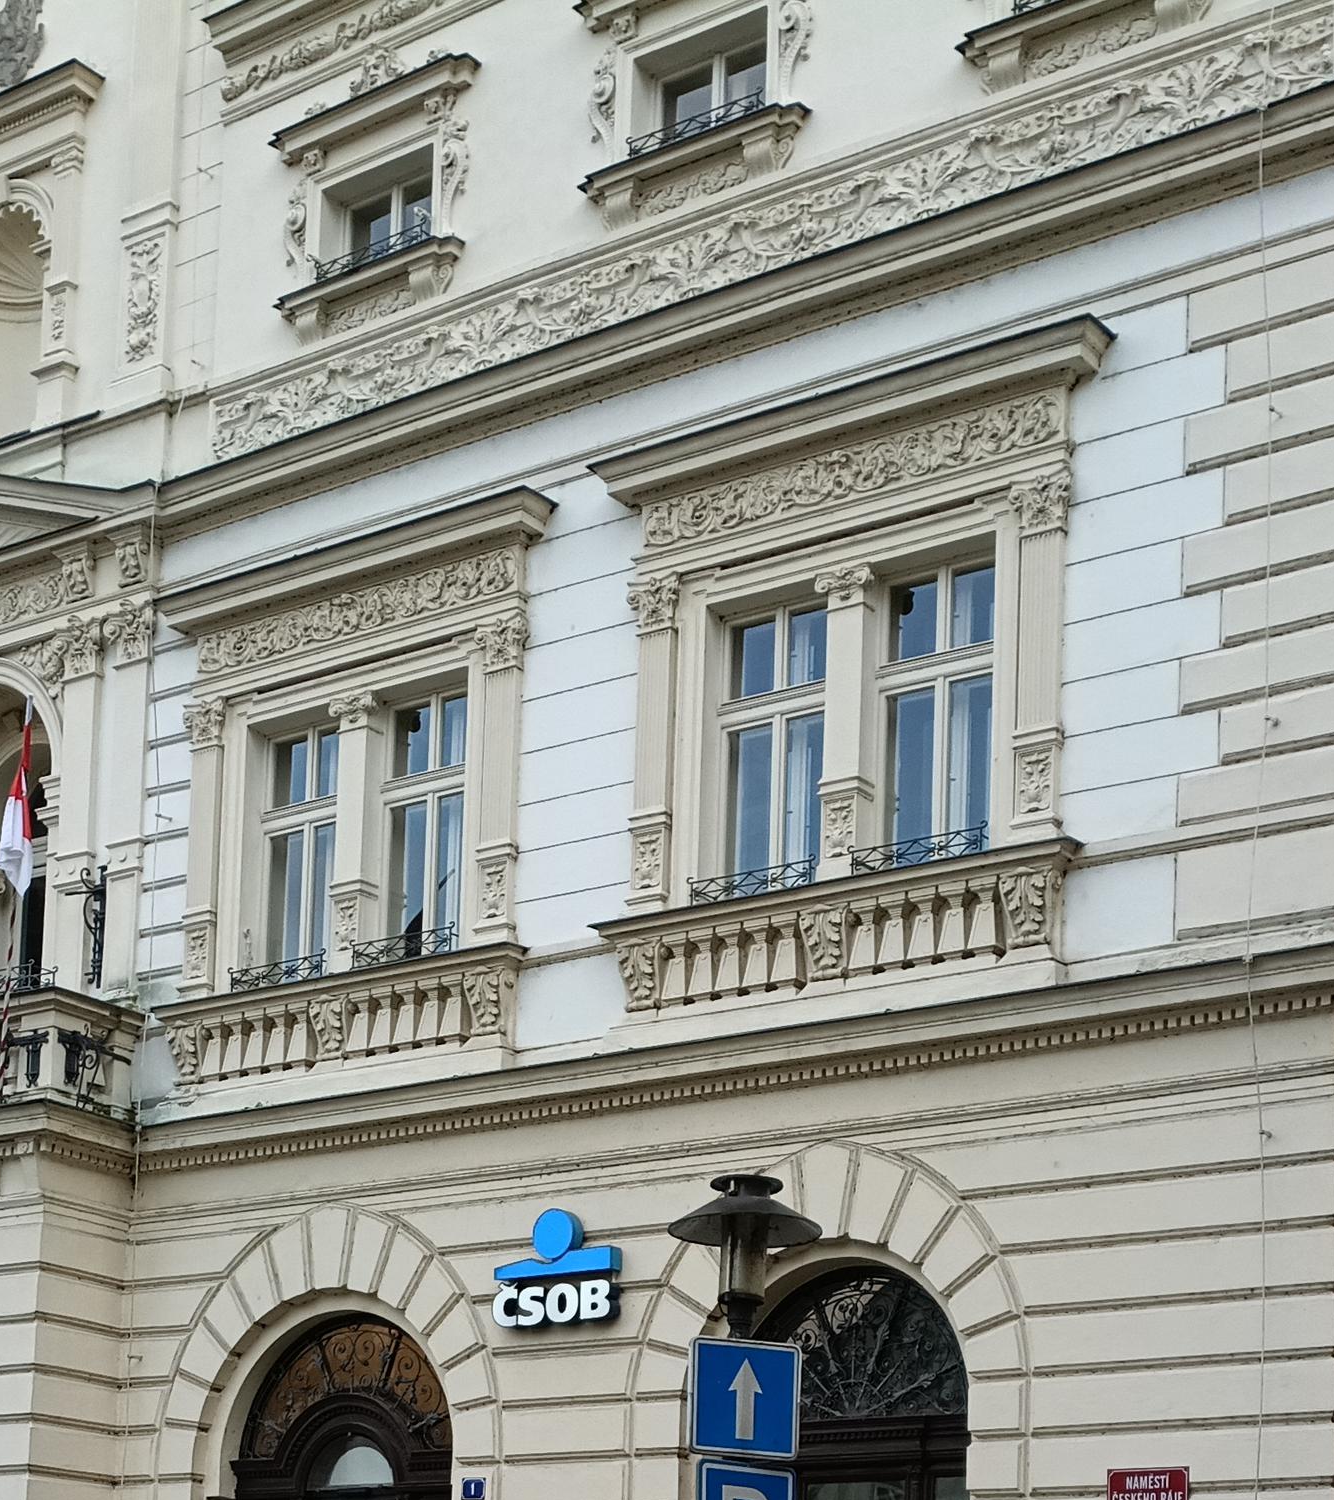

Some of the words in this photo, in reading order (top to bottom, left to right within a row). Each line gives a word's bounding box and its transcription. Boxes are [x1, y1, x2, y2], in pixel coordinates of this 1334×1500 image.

[491, 1278, 614, 1328] ČSOB
[470, 1482, 476, 1496] 1
[1125, 1472, 1170, 1489] NÁMĚSTÍ
